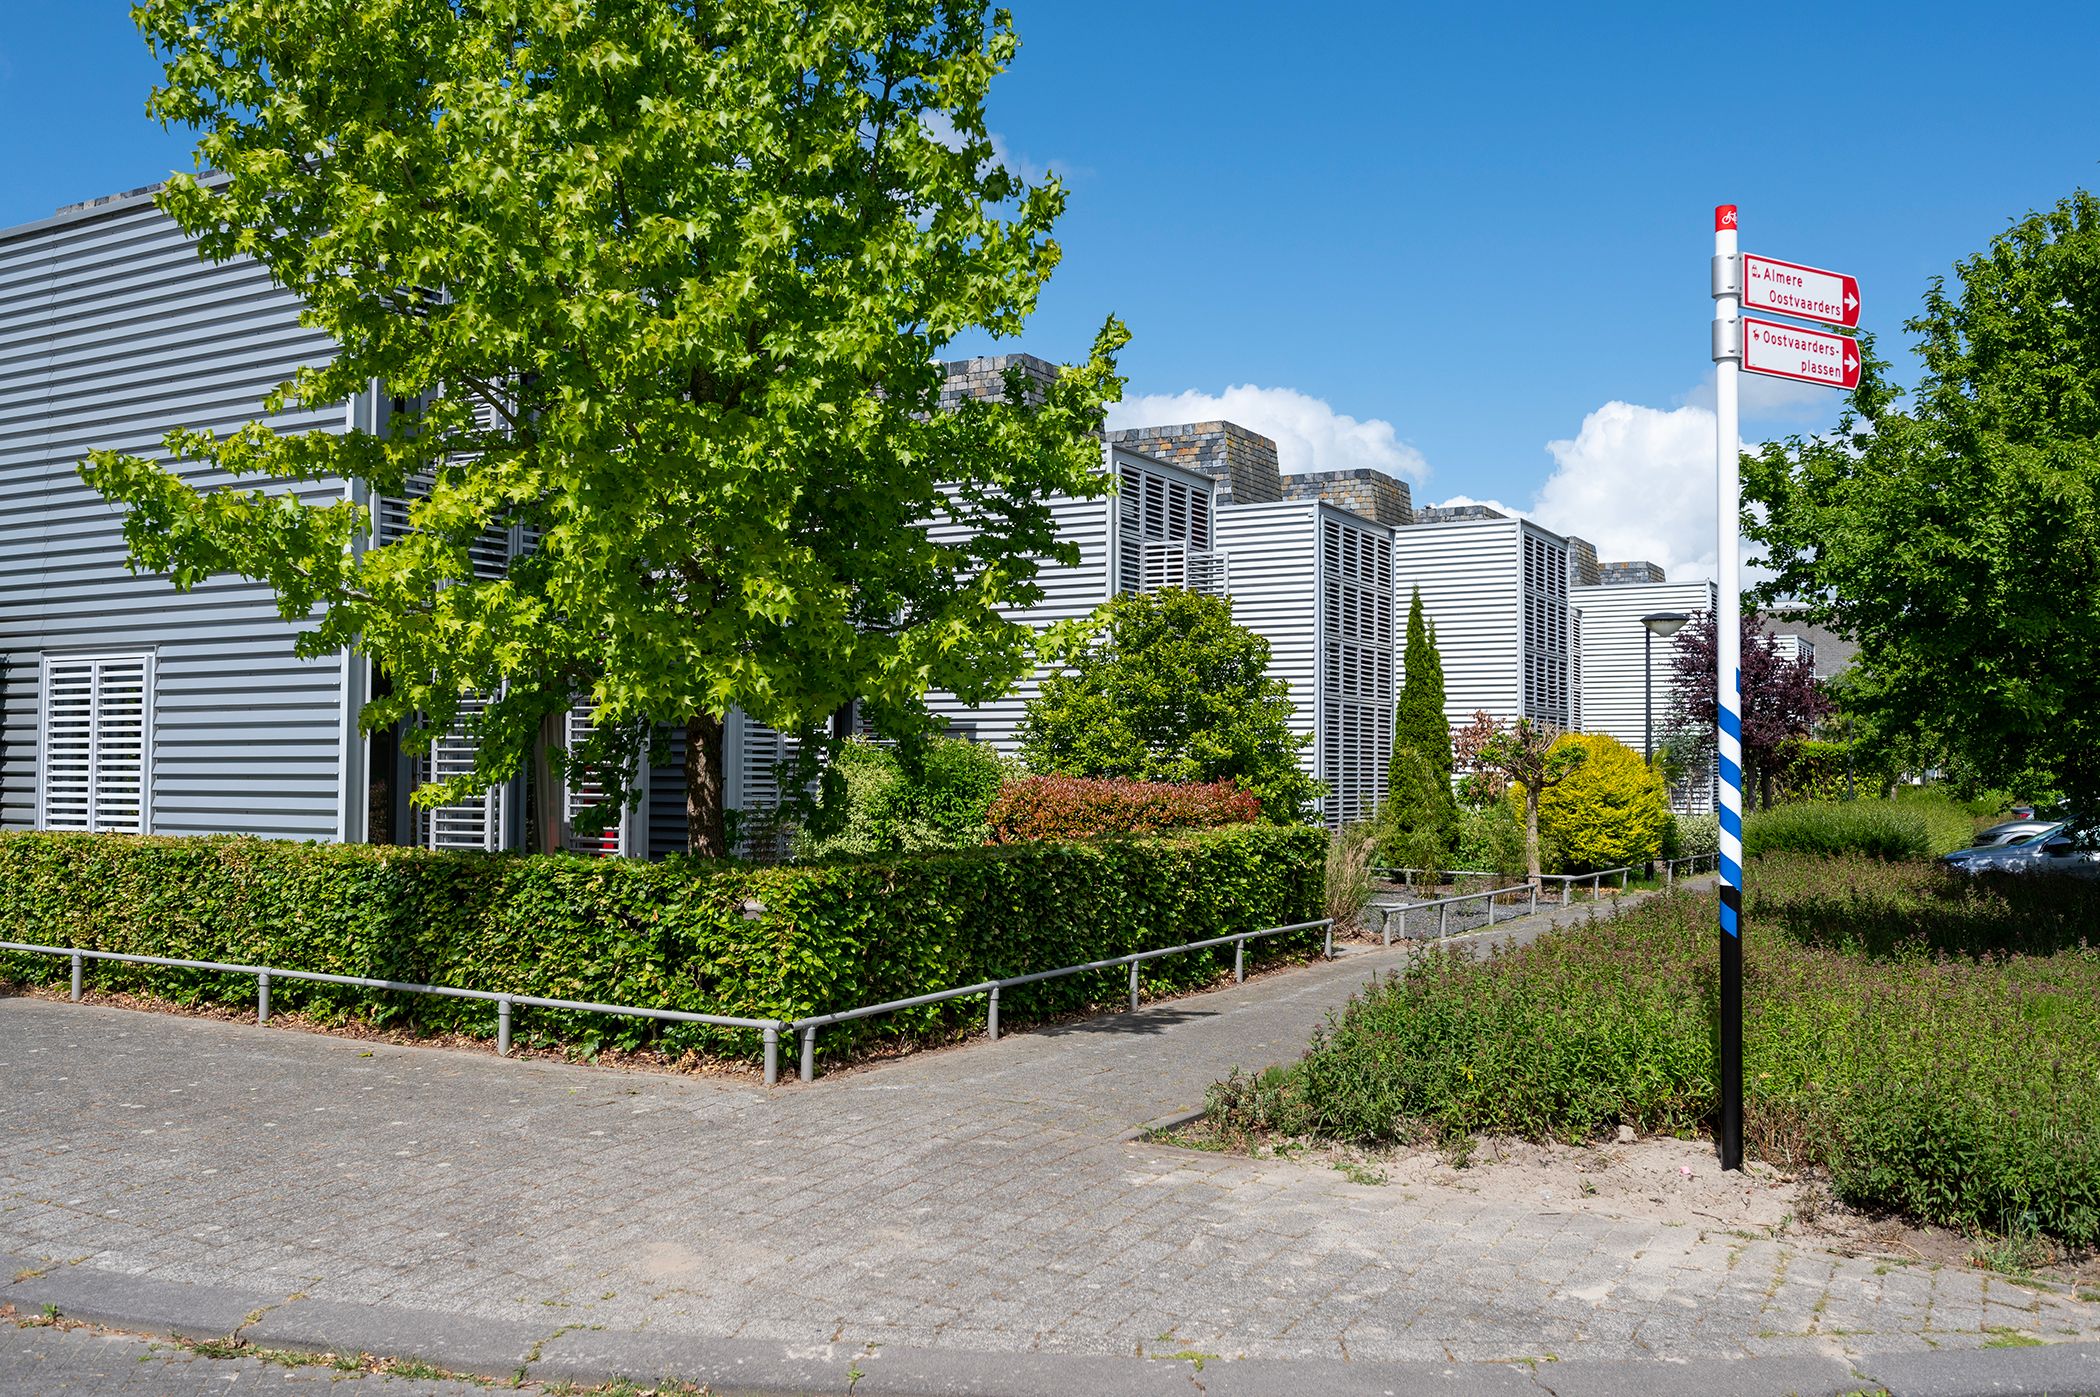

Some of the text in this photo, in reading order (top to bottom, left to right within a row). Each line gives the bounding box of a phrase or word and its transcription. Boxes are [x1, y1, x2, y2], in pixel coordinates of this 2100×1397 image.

[1763, 267, 1803, 288] Almere
[1769, 289, 1841, 316] Oostvaarders
[1763, 330, 1840, 356] Oostvaarders-
[1801, 360, 1841, 378] plassen
